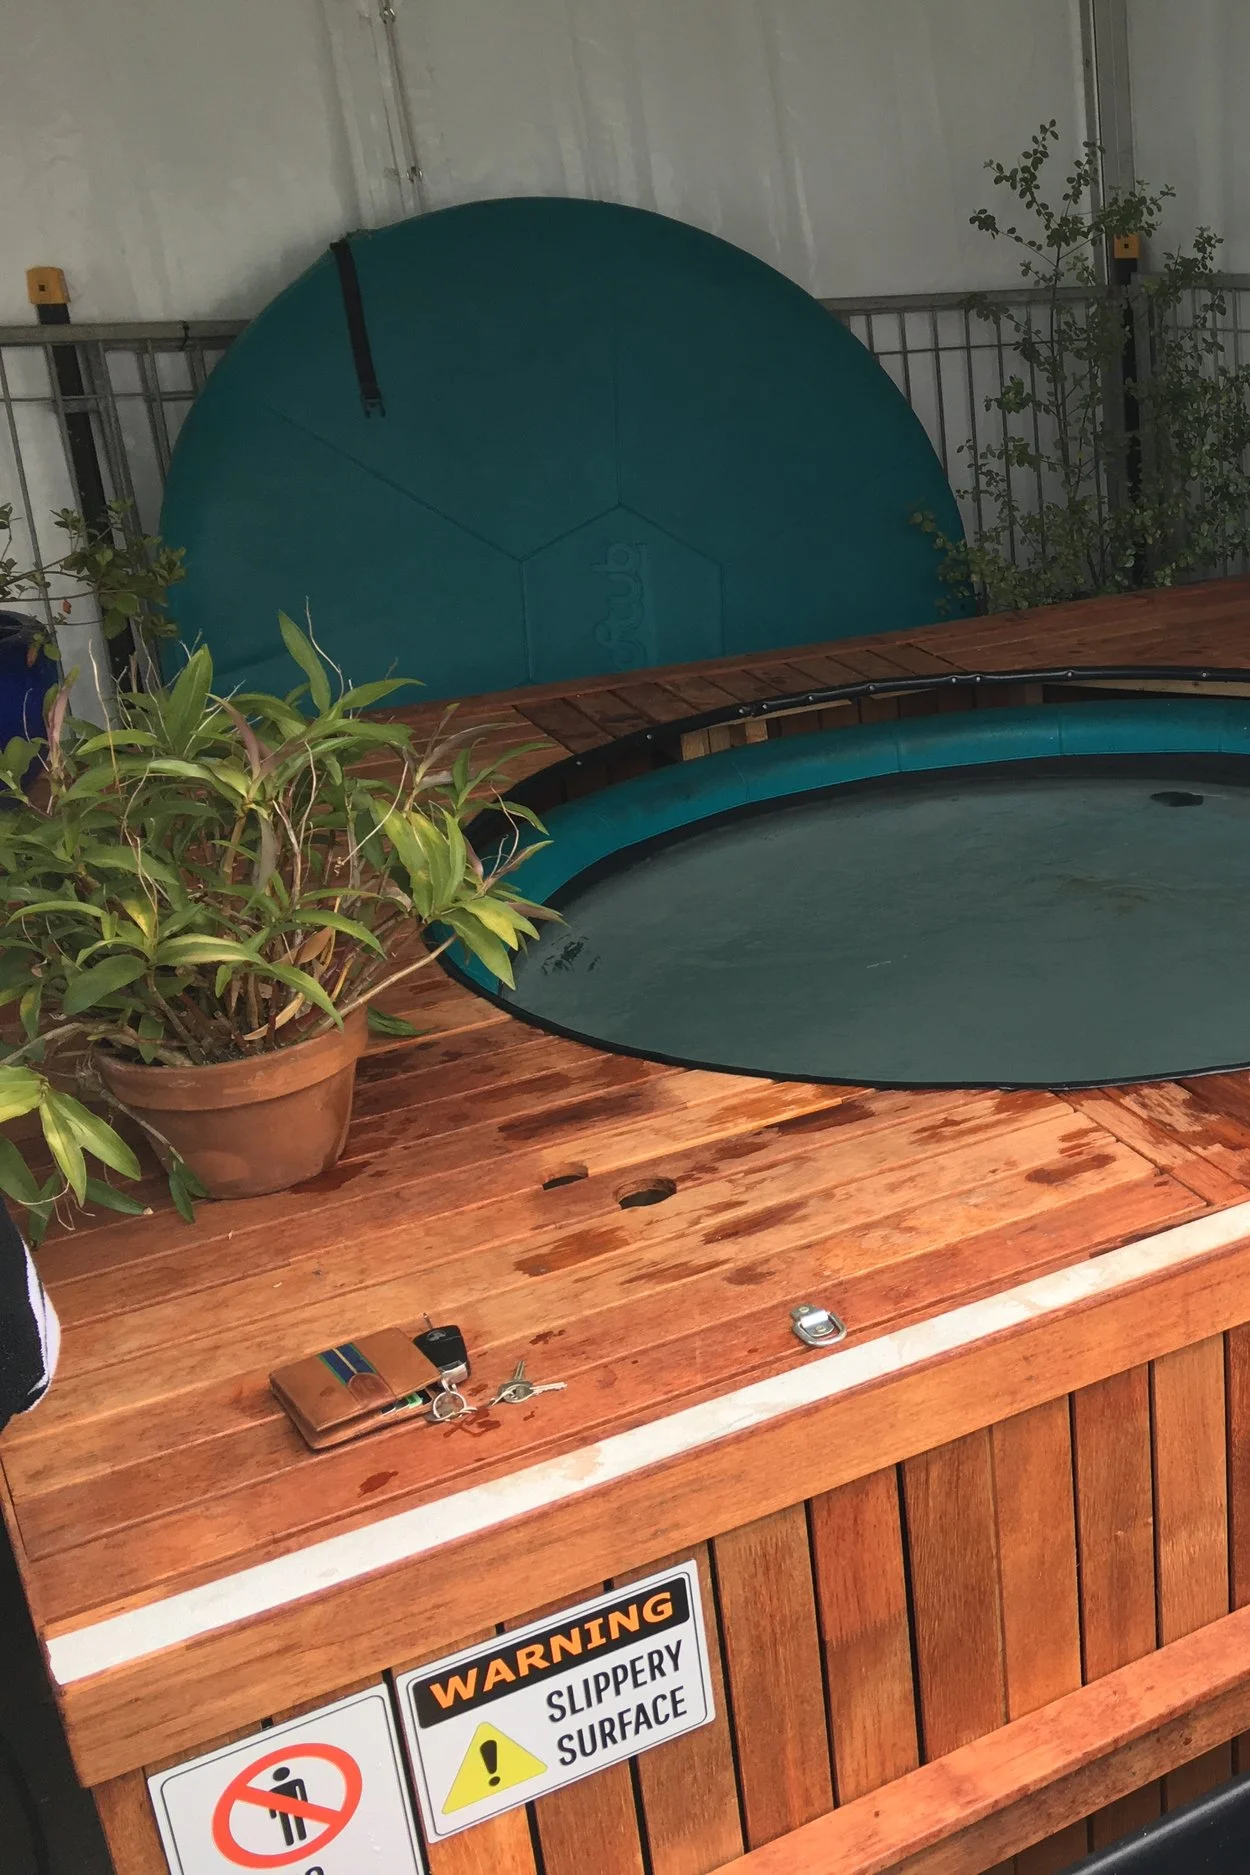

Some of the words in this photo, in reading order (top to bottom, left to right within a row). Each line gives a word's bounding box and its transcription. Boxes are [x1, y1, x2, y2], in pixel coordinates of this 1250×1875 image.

[429, 1592, 673, 1709] WARNING
[546, 1639, 682, 1723] SLIPPERY
[556, 1685, 688, 1767] SURFACE
